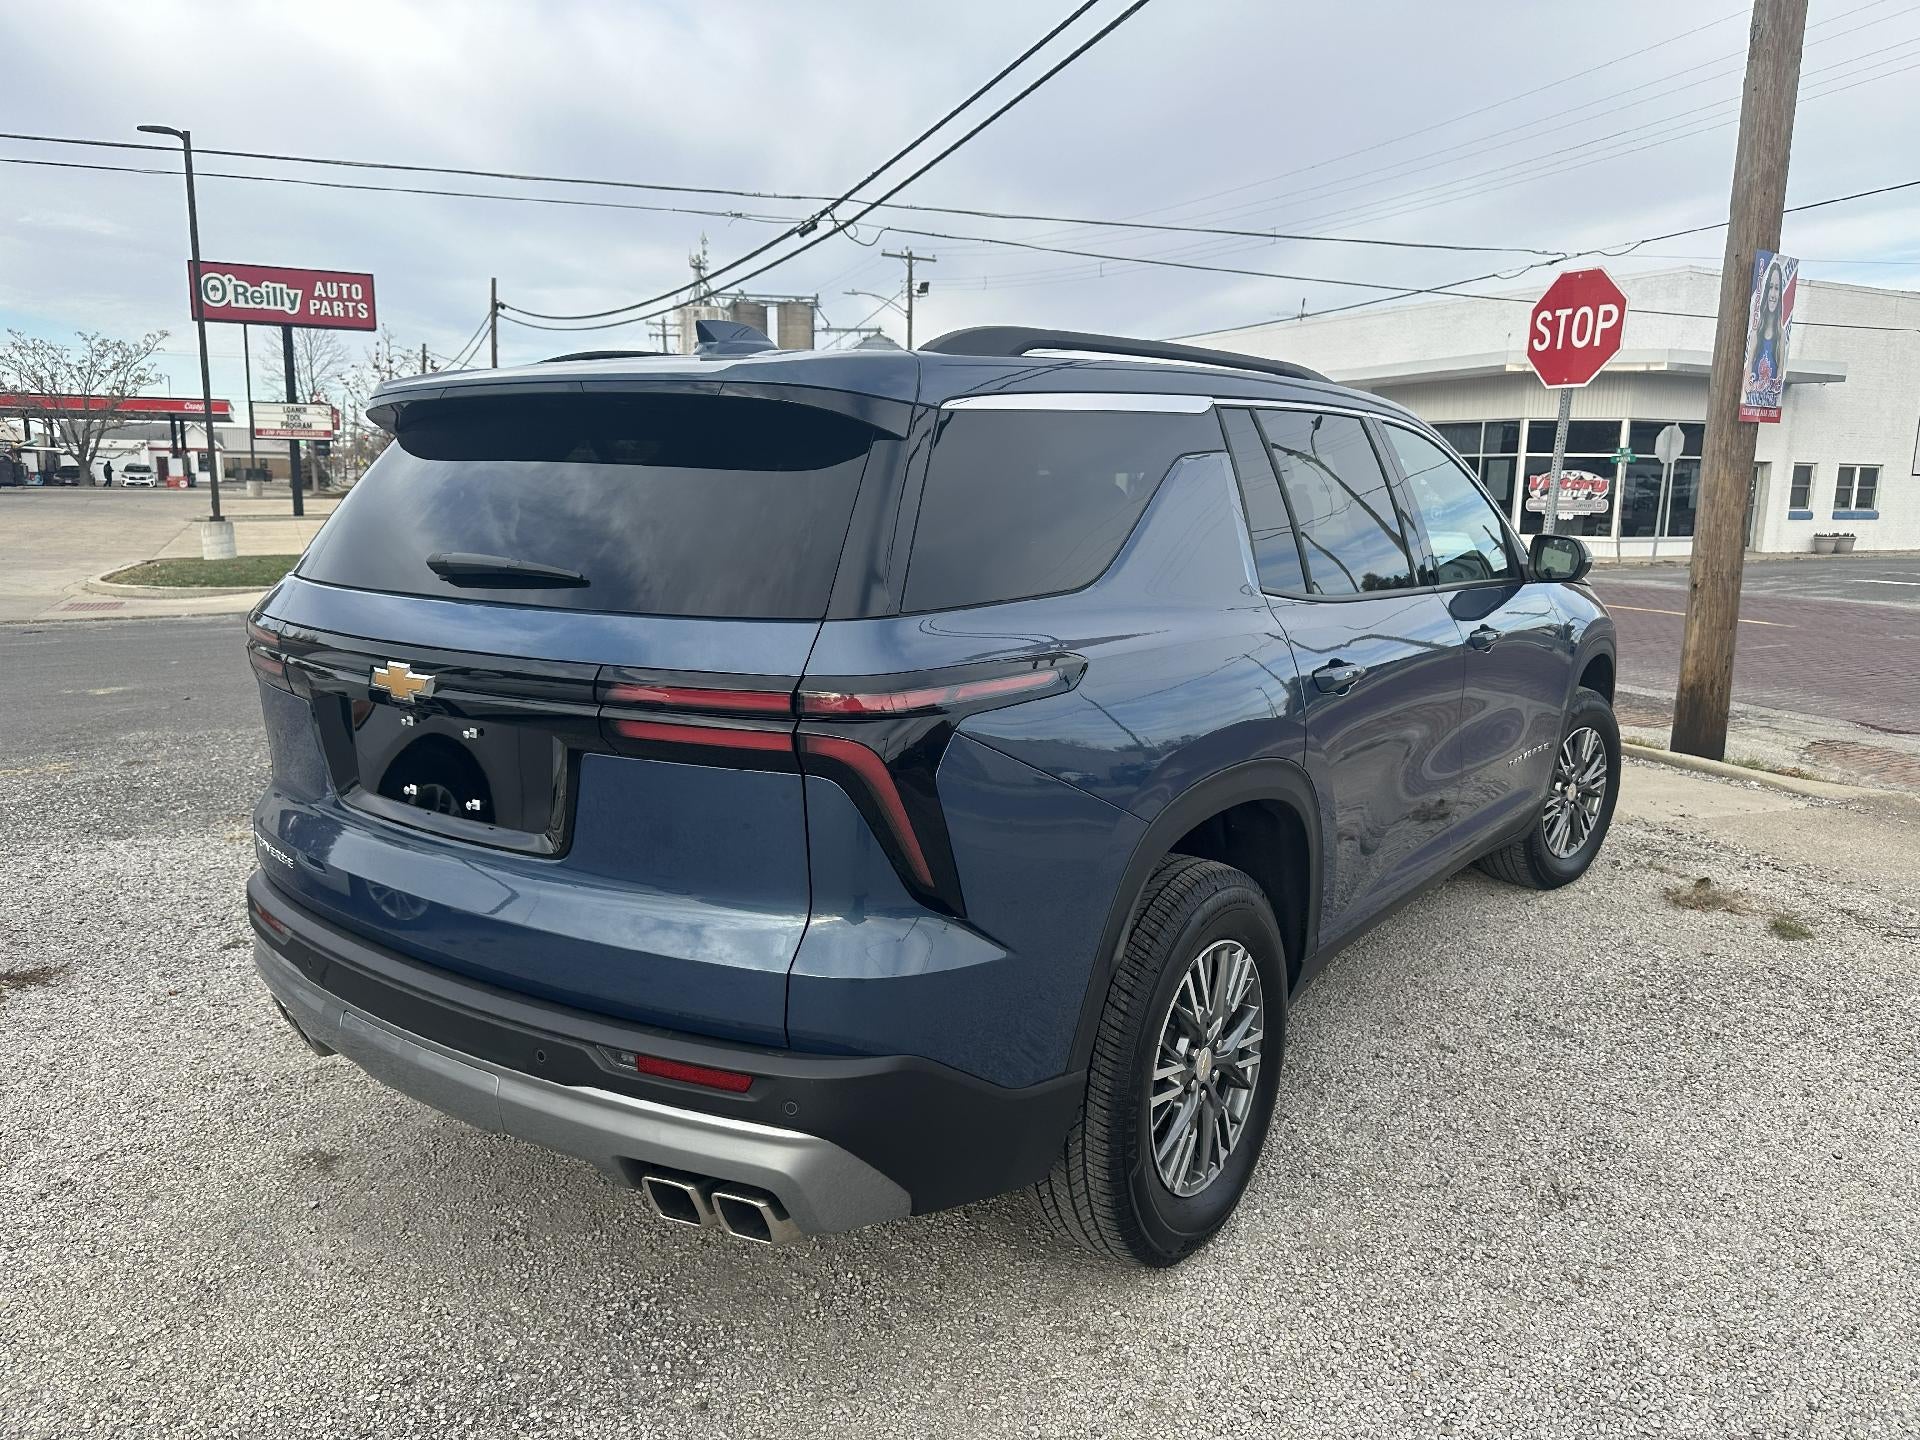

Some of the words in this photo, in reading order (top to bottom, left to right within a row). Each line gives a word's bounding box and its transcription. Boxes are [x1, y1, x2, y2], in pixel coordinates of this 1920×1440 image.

[202, 275, 299, 311] O'Reilly
[314, 281, 362, 300] AUTO
[309, 299, 368, 319] PARTS
[1533, 304, 1619, 352] STOP
[283, 406, 307, 414] LOANER
[286, 414, 302, 422] TOOL
[281, 421, 312, 430] PROGRAM
